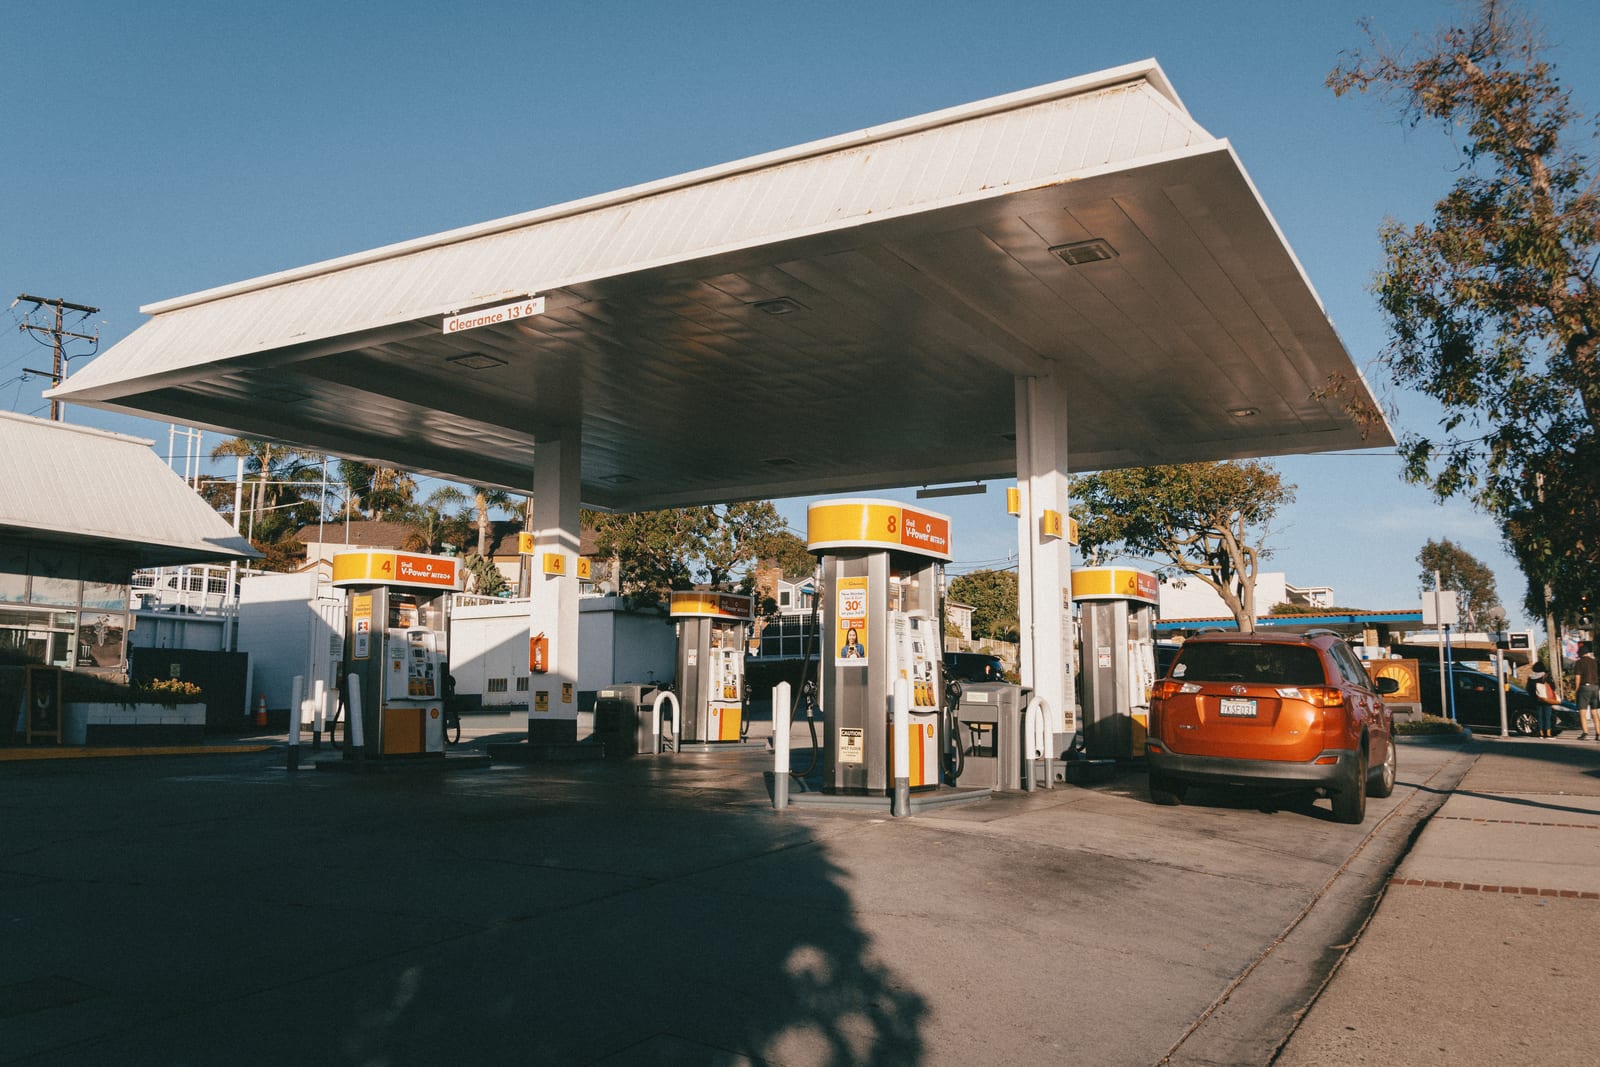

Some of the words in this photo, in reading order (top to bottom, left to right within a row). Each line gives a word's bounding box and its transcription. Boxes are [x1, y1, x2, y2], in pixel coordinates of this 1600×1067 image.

[449, 313, 503, 331] Clearance
[507, 306, 522, 319] 13'
[525, 303, 537, 315] 6"
[887, 515, 897, 533] 8
[1054, 516, 1059, 531] 8
[906, 527, 929, 541] V-Power
[526, 538, 532, 549] 3
[382, 560, 391, 573] 4
[553, 558, 560, 570] 4
[581, 563, 587, 574] 2
[401, 568, 430, 577] V-Power
[1128, 576, 1135, 588] 6
